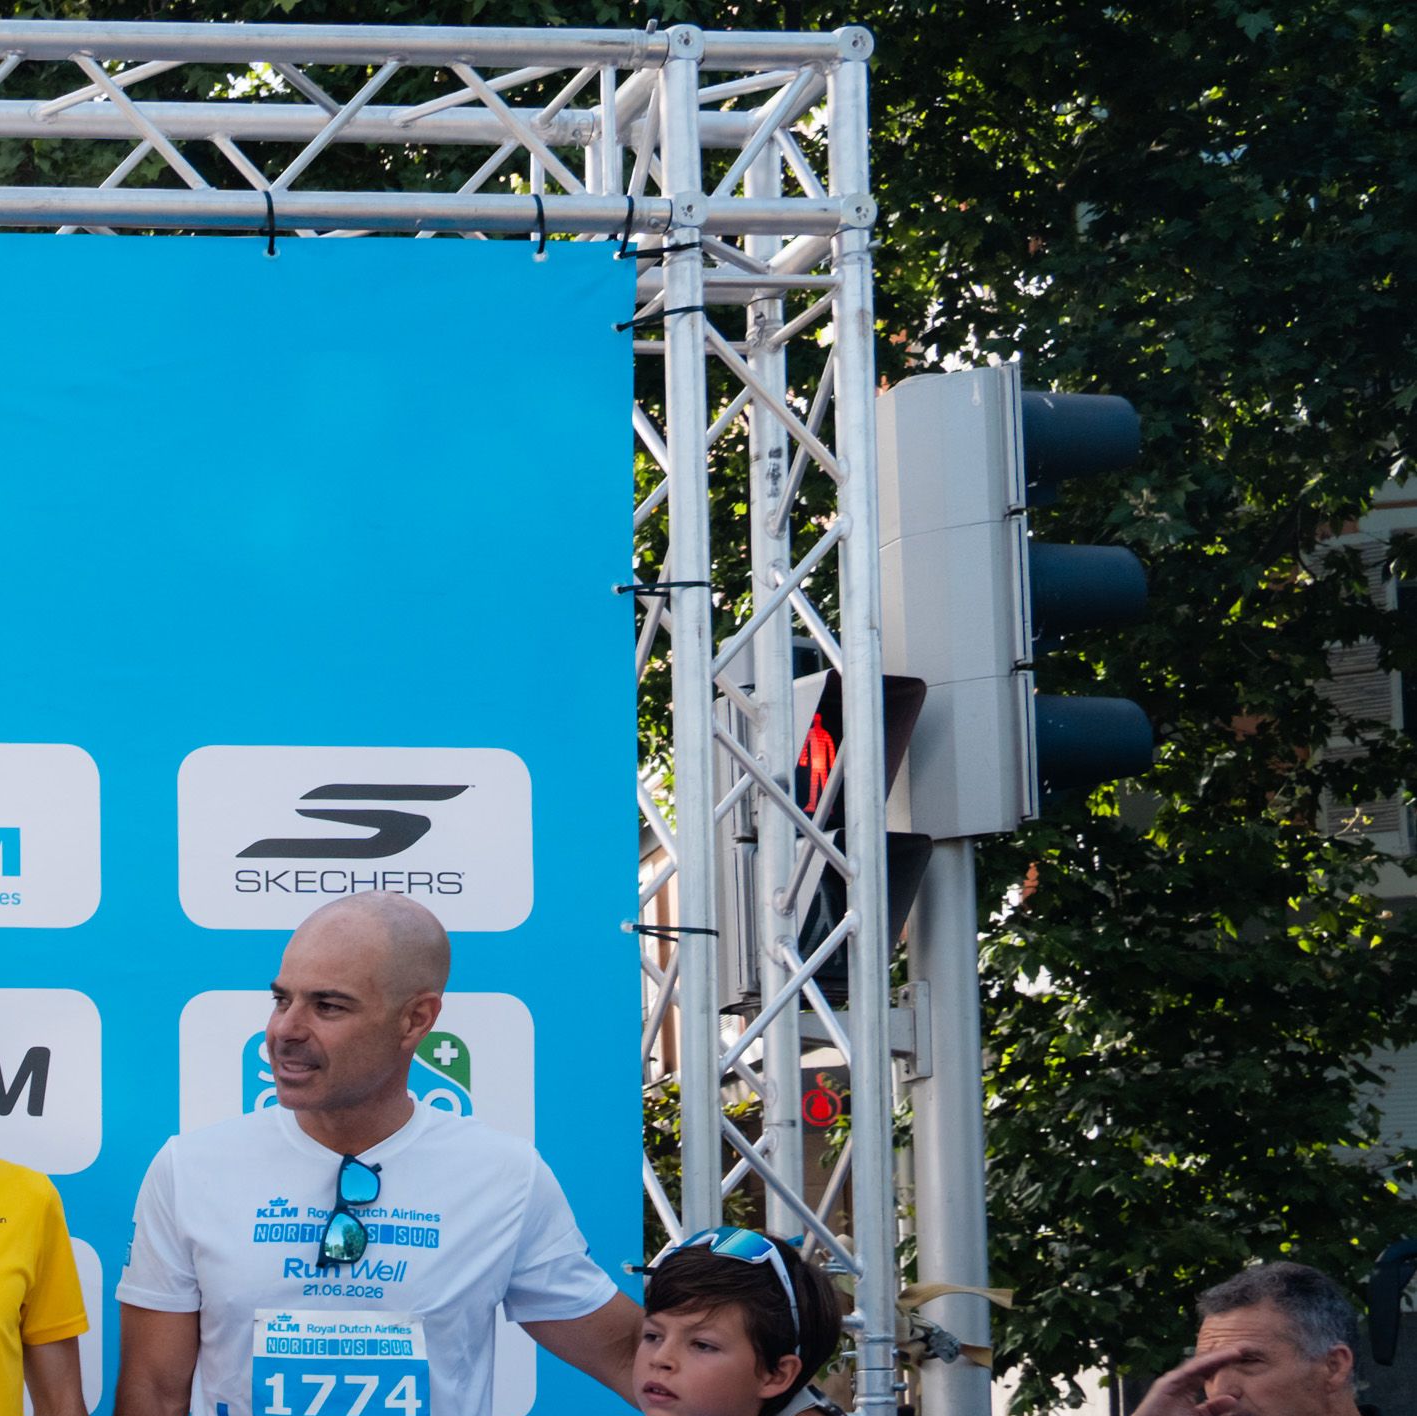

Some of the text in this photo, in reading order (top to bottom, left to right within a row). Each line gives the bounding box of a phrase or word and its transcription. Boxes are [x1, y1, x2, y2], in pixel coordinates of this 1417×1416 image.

[235, 870, 463, 895] SKECHERS
[256, 1207, 299, 1218] KLM
[307, 1208, 333, 1221] Roy
[391, 1207, 441, 1222] Airlines
[397, 1227, 439, 1248] SUR
[283, 1257, 407, 1282] Run Well
[303, 1284, 384, 1299] 21.06.2026
[268, 1322, 412, 1335] KLM Royal Dutch Airlines
[268, 1338, 413, 1355] NORTE VS SUR
